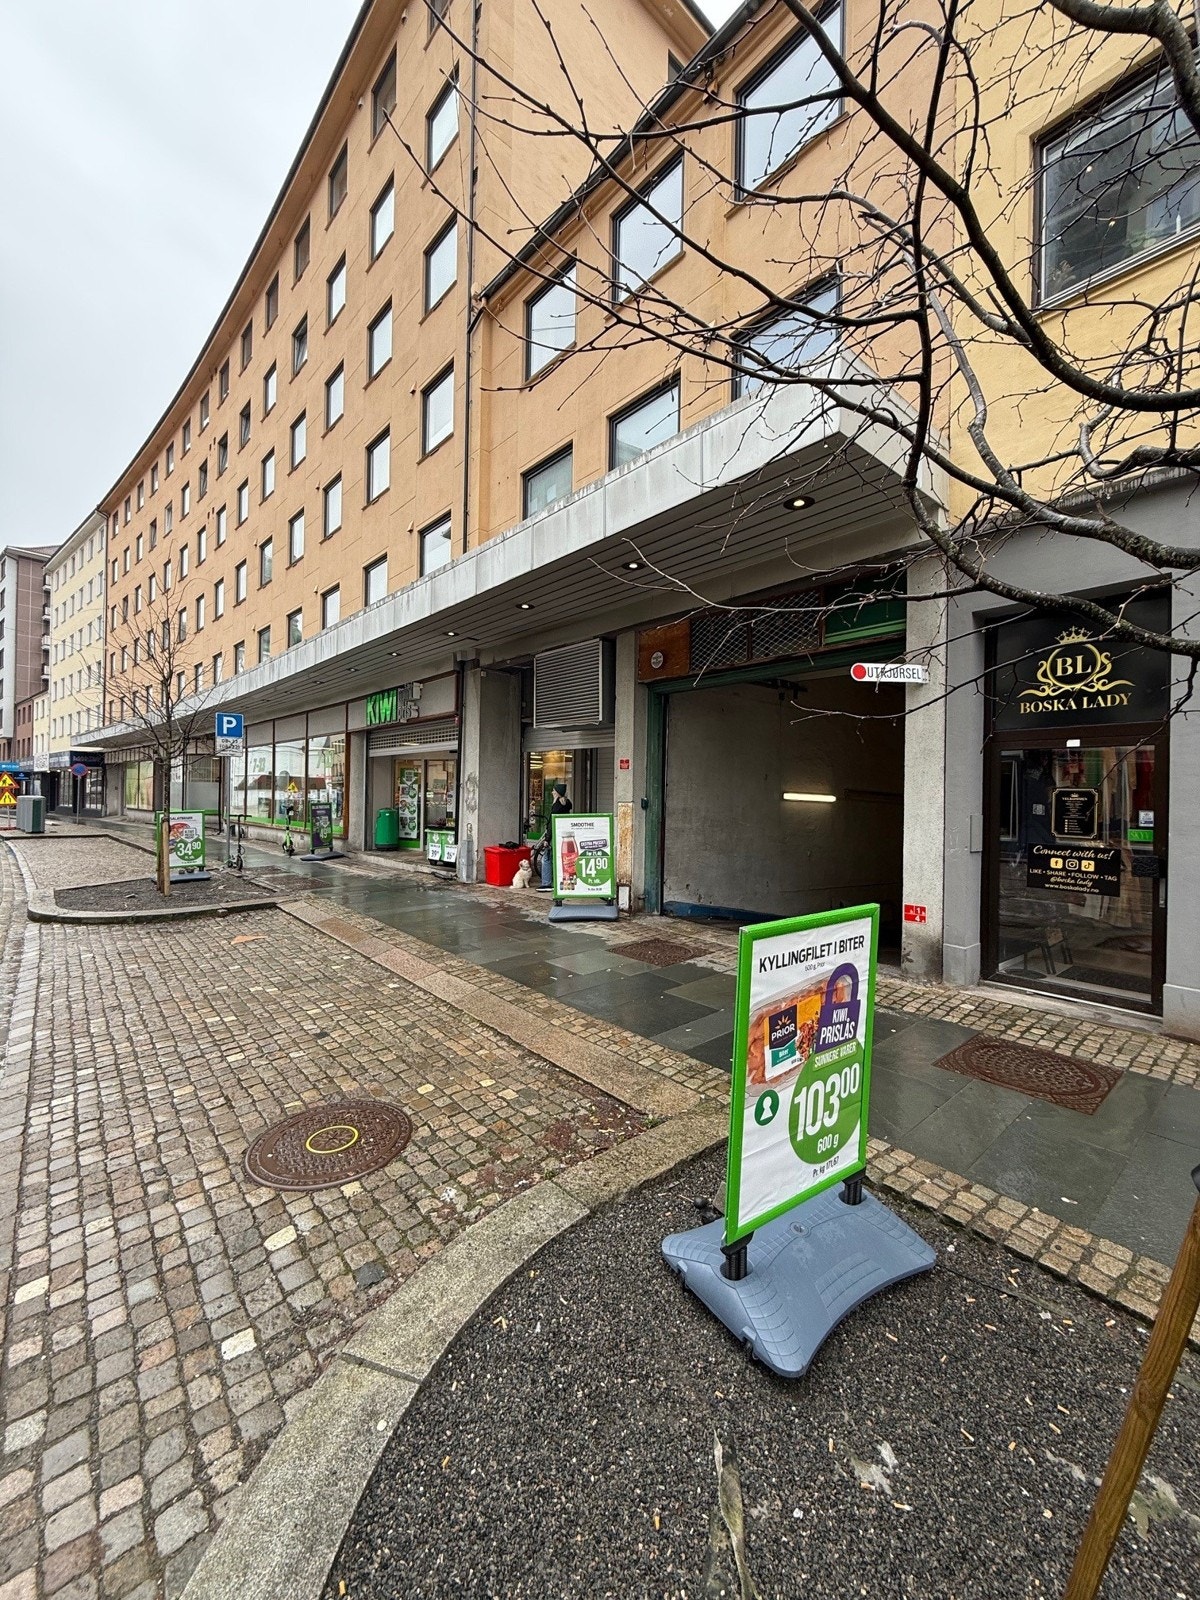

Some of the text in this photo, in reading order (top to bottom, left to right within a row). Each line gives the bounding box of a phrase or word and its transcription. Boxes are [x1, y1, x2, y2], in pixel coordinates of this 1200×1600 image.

[867, 667, 921, 680] UTKJØRSEL
[1055, 655, 1092, 677] BL
[367, 690, 397, 726] KIWI
[1020, 692, 1132, 714] BOSKA LADY
[223, 717, 237, 734] P
[1033, 845, 1115, 860] Connect with us!
[759, 935, 865, 974] KYLLINGFILET I BITER
[832, 1008, 848, 1024] KIWI
[771, 1023, 795, 1042] PRIOR
[820, 1018, 856, 1045] PRISLÅS
[814, 1047, 840, 1069] SUNNERE
[840, 1041, 857, 1058] VARER
[817, 1133, 840, 1154] 600 g
[819, 1165, 826, 1174] kg
[826, 1155, 840, 1170] 171,67
